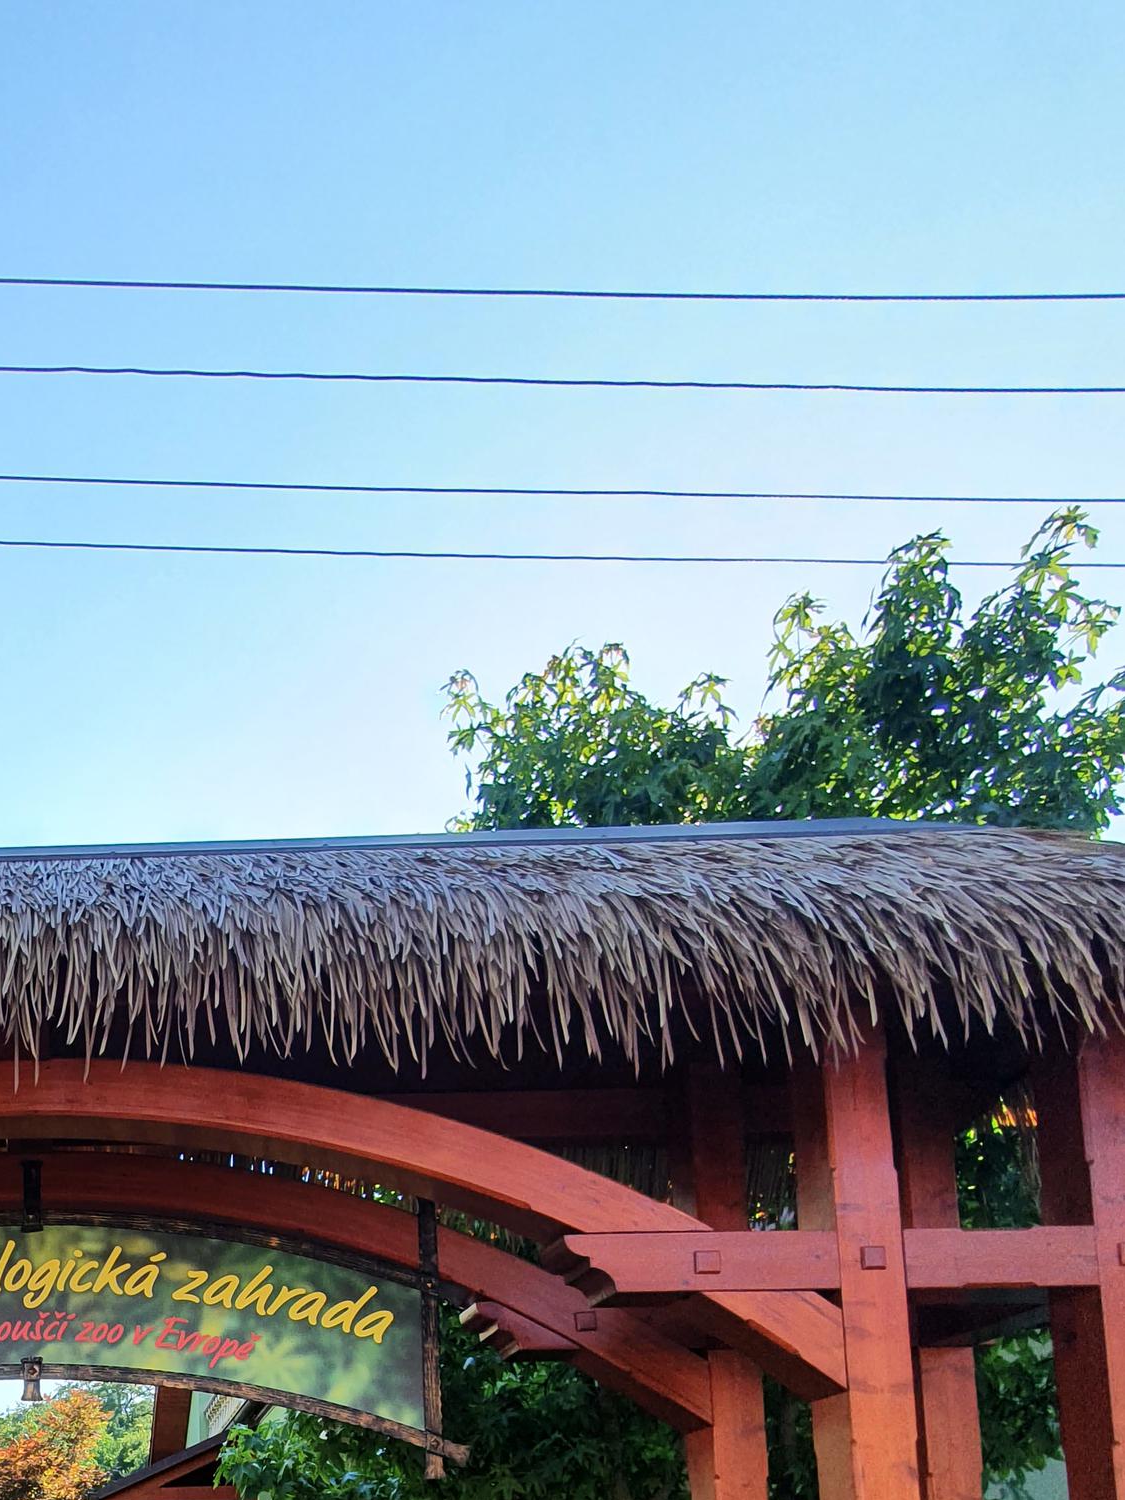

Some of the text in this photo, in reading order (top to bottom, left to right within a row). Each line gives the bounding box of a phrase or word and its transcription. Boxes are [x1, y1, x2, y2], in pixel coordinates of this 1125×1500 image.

[171, 1265, 395, 1345] zahrada
[75, 1320, 124, 1345] zoo
[132, 1323, 155, 1346] v
[155, 1316, 263, 1370] Evropě
